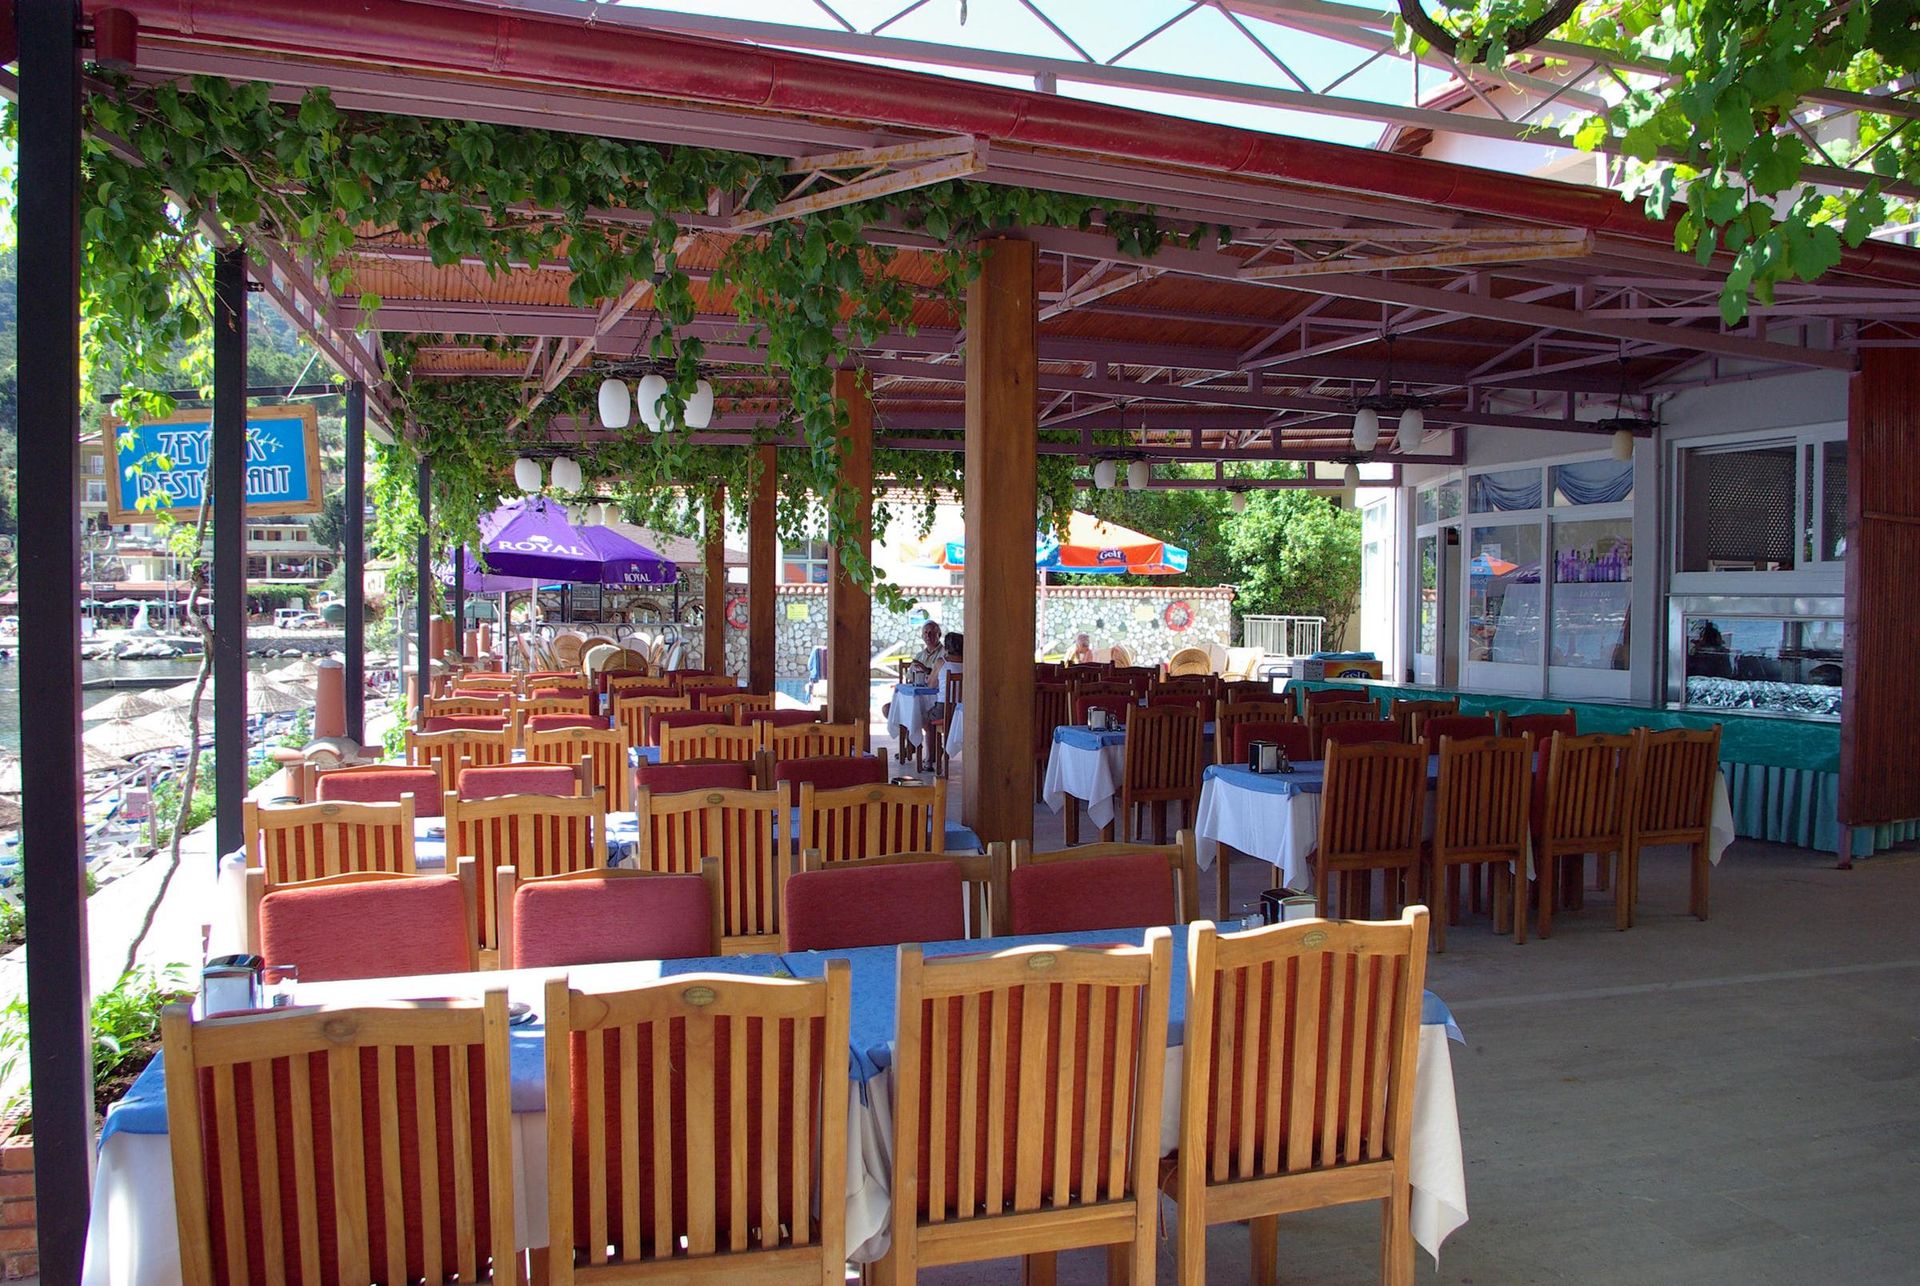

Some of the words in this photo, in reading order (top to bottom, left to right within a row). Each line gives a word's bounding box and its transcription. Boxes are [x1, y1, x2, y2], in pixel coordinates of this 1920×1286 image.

[157, 429, 267, 465] ZEYK
[136, 464, 291, 500] RESTANT
[498, 541, 584, 556] ROYAL
[1099, 550, 1122, 560] Golf
[623, 573, 651, 583] ROYAL
